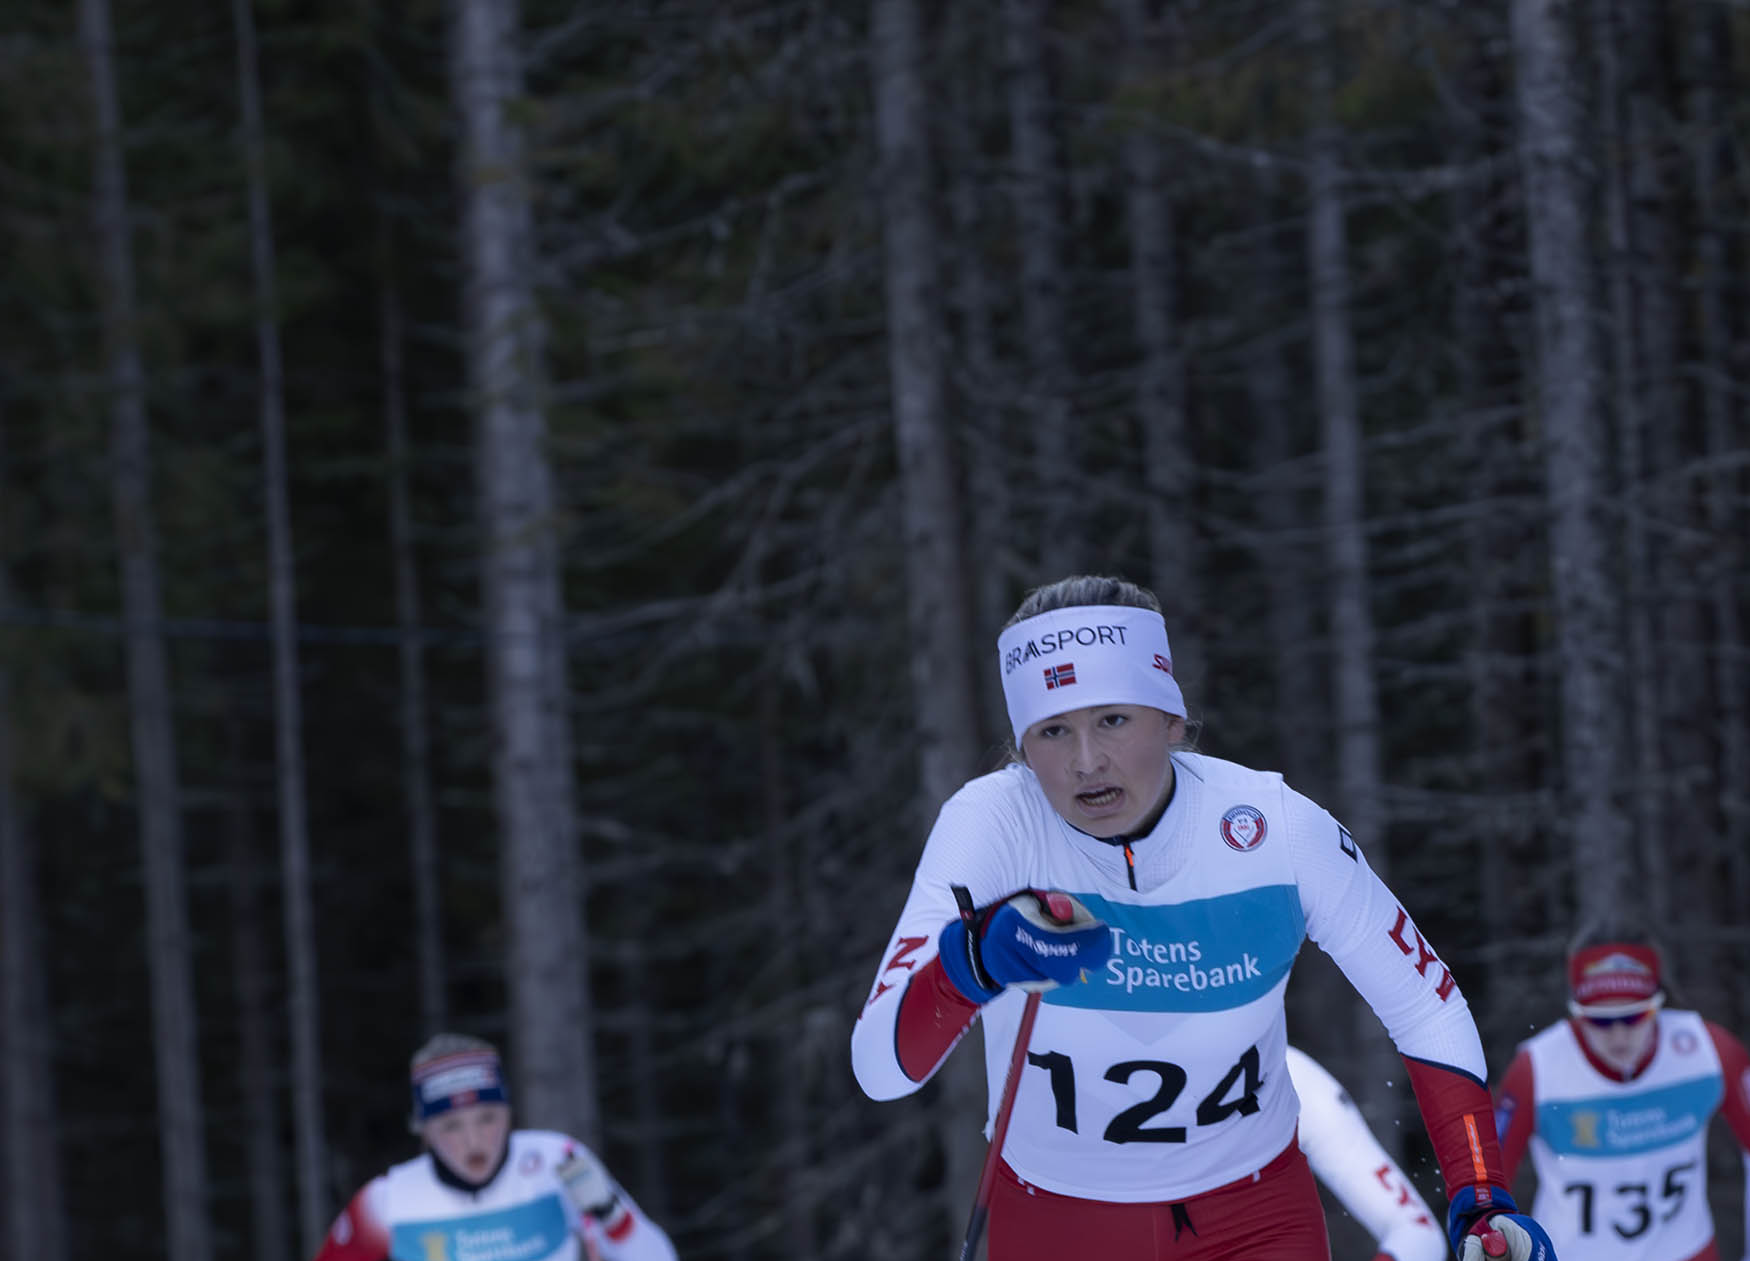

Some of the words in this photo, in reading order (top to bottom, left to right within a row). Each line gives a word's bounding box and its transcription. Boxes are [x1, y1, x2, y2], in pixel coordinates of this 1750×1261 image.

[1106, 953, 1262, 994] Sparebank
[1109, 928, 1202, 964] Totens
[1028, 1045, 1264, 1144] 124
[1564, 1158, 1698, 1240] 135
